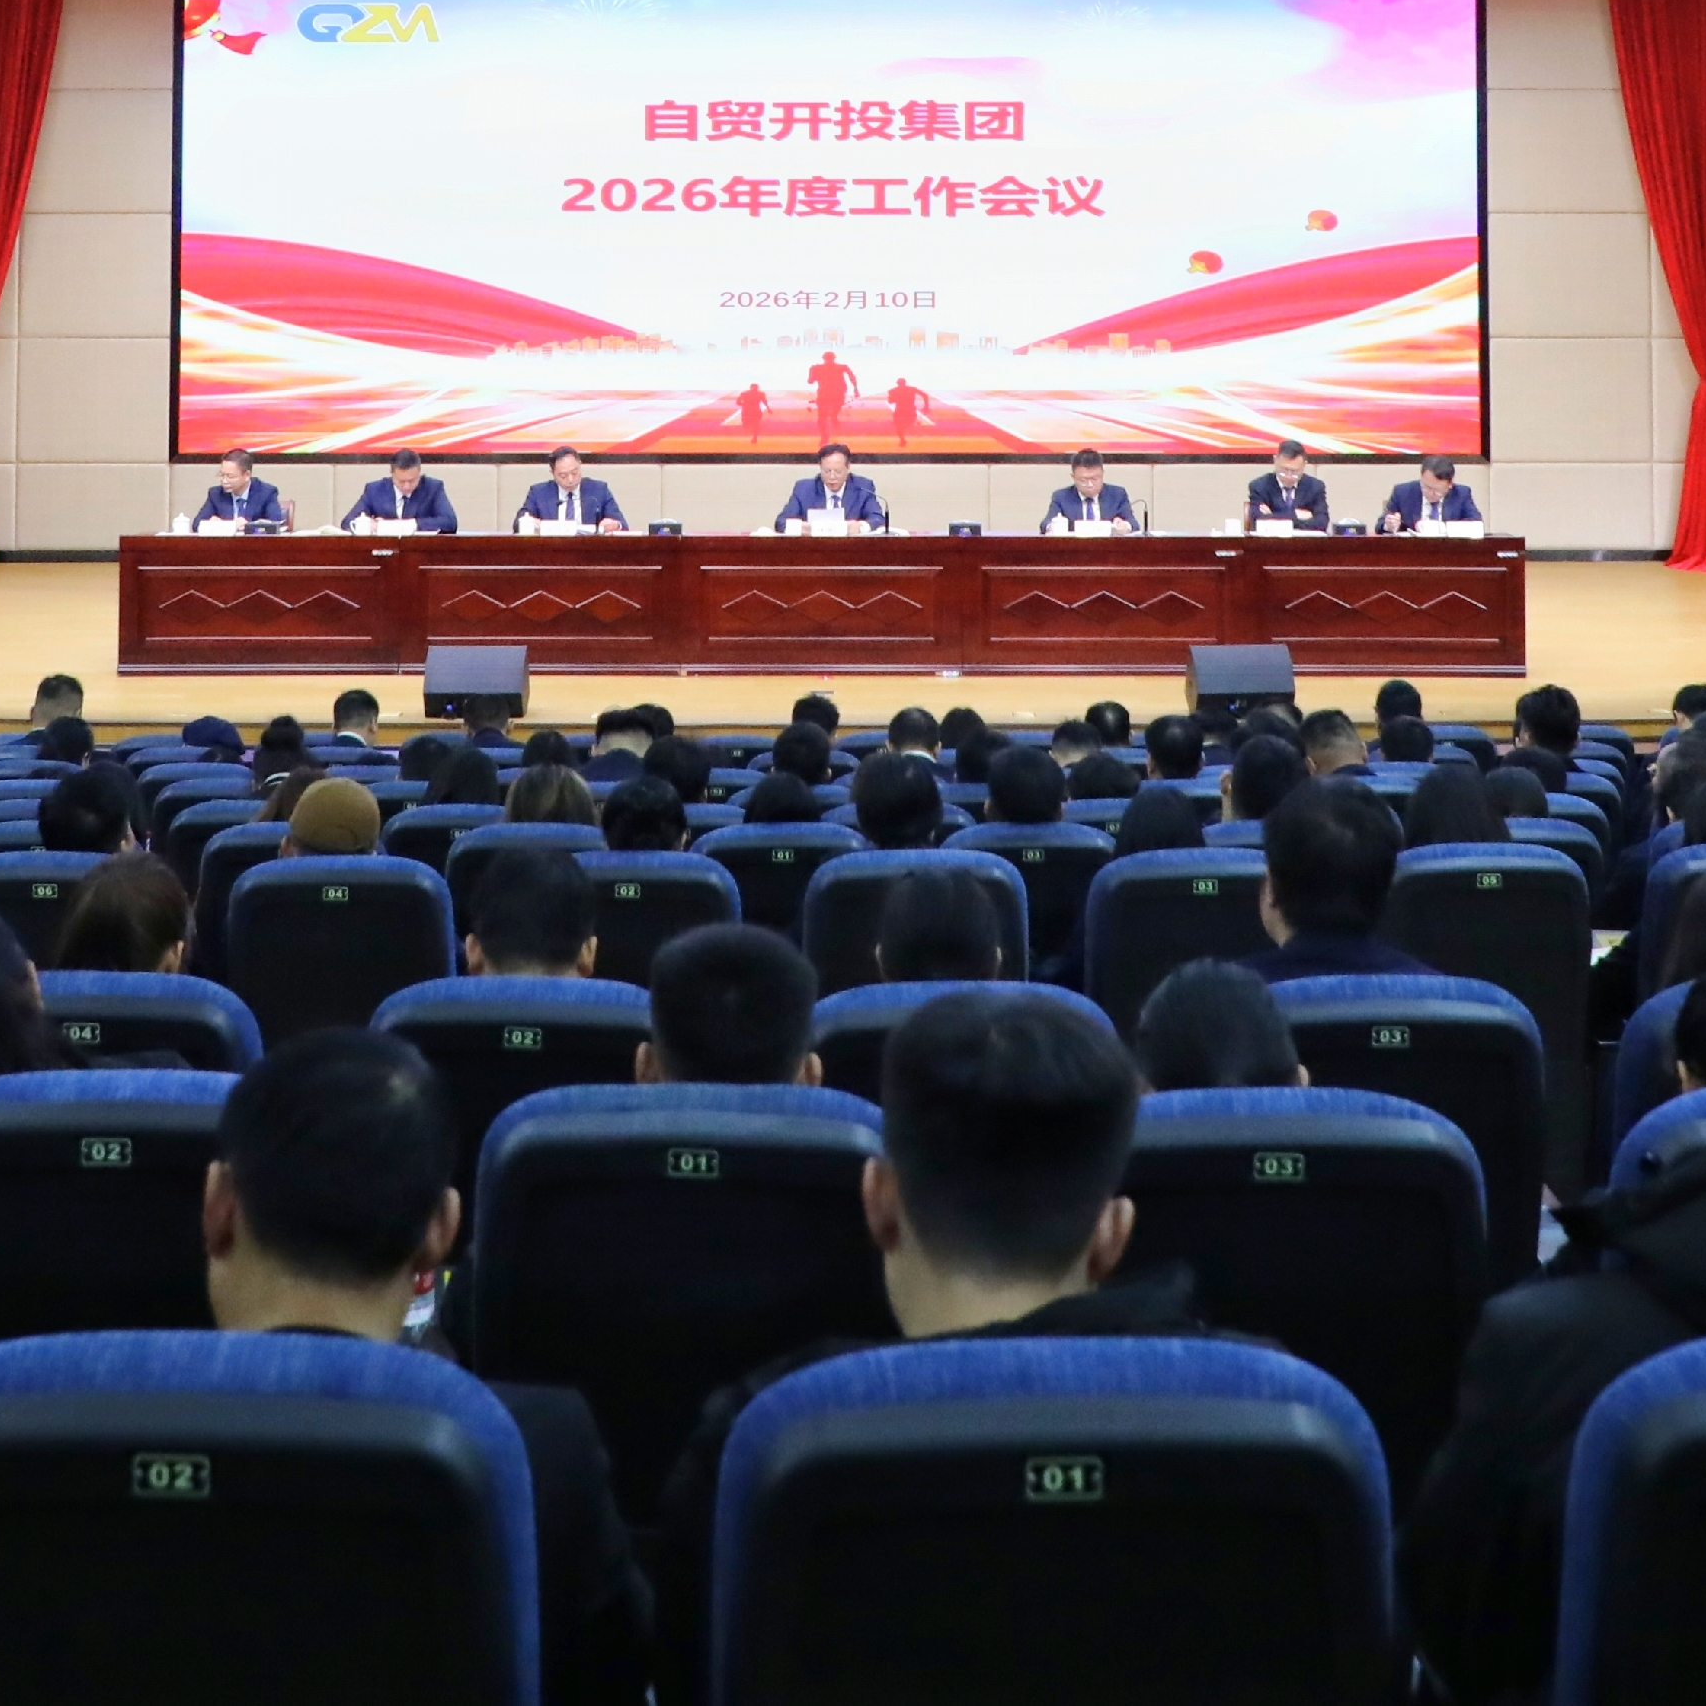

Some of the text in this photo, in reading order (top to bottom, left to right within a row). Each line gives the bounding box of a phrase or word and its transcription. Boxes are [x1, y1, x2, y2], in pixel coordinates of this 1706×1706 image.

[643, 98, 1026, 142] 自贸开投集团
[561, 172, 1105, 219] 2026年度工作会议
[719, 290, 937, 310] 2026年2月10日
[90, 1144, 123, 1161] 02
[679, 1155, 708, 1172] 01
[1264, 1159, 1294, 1176] 03
[148, 1461, 195, 1488] 02
[1042, 1466, 1086, 1492] 01
